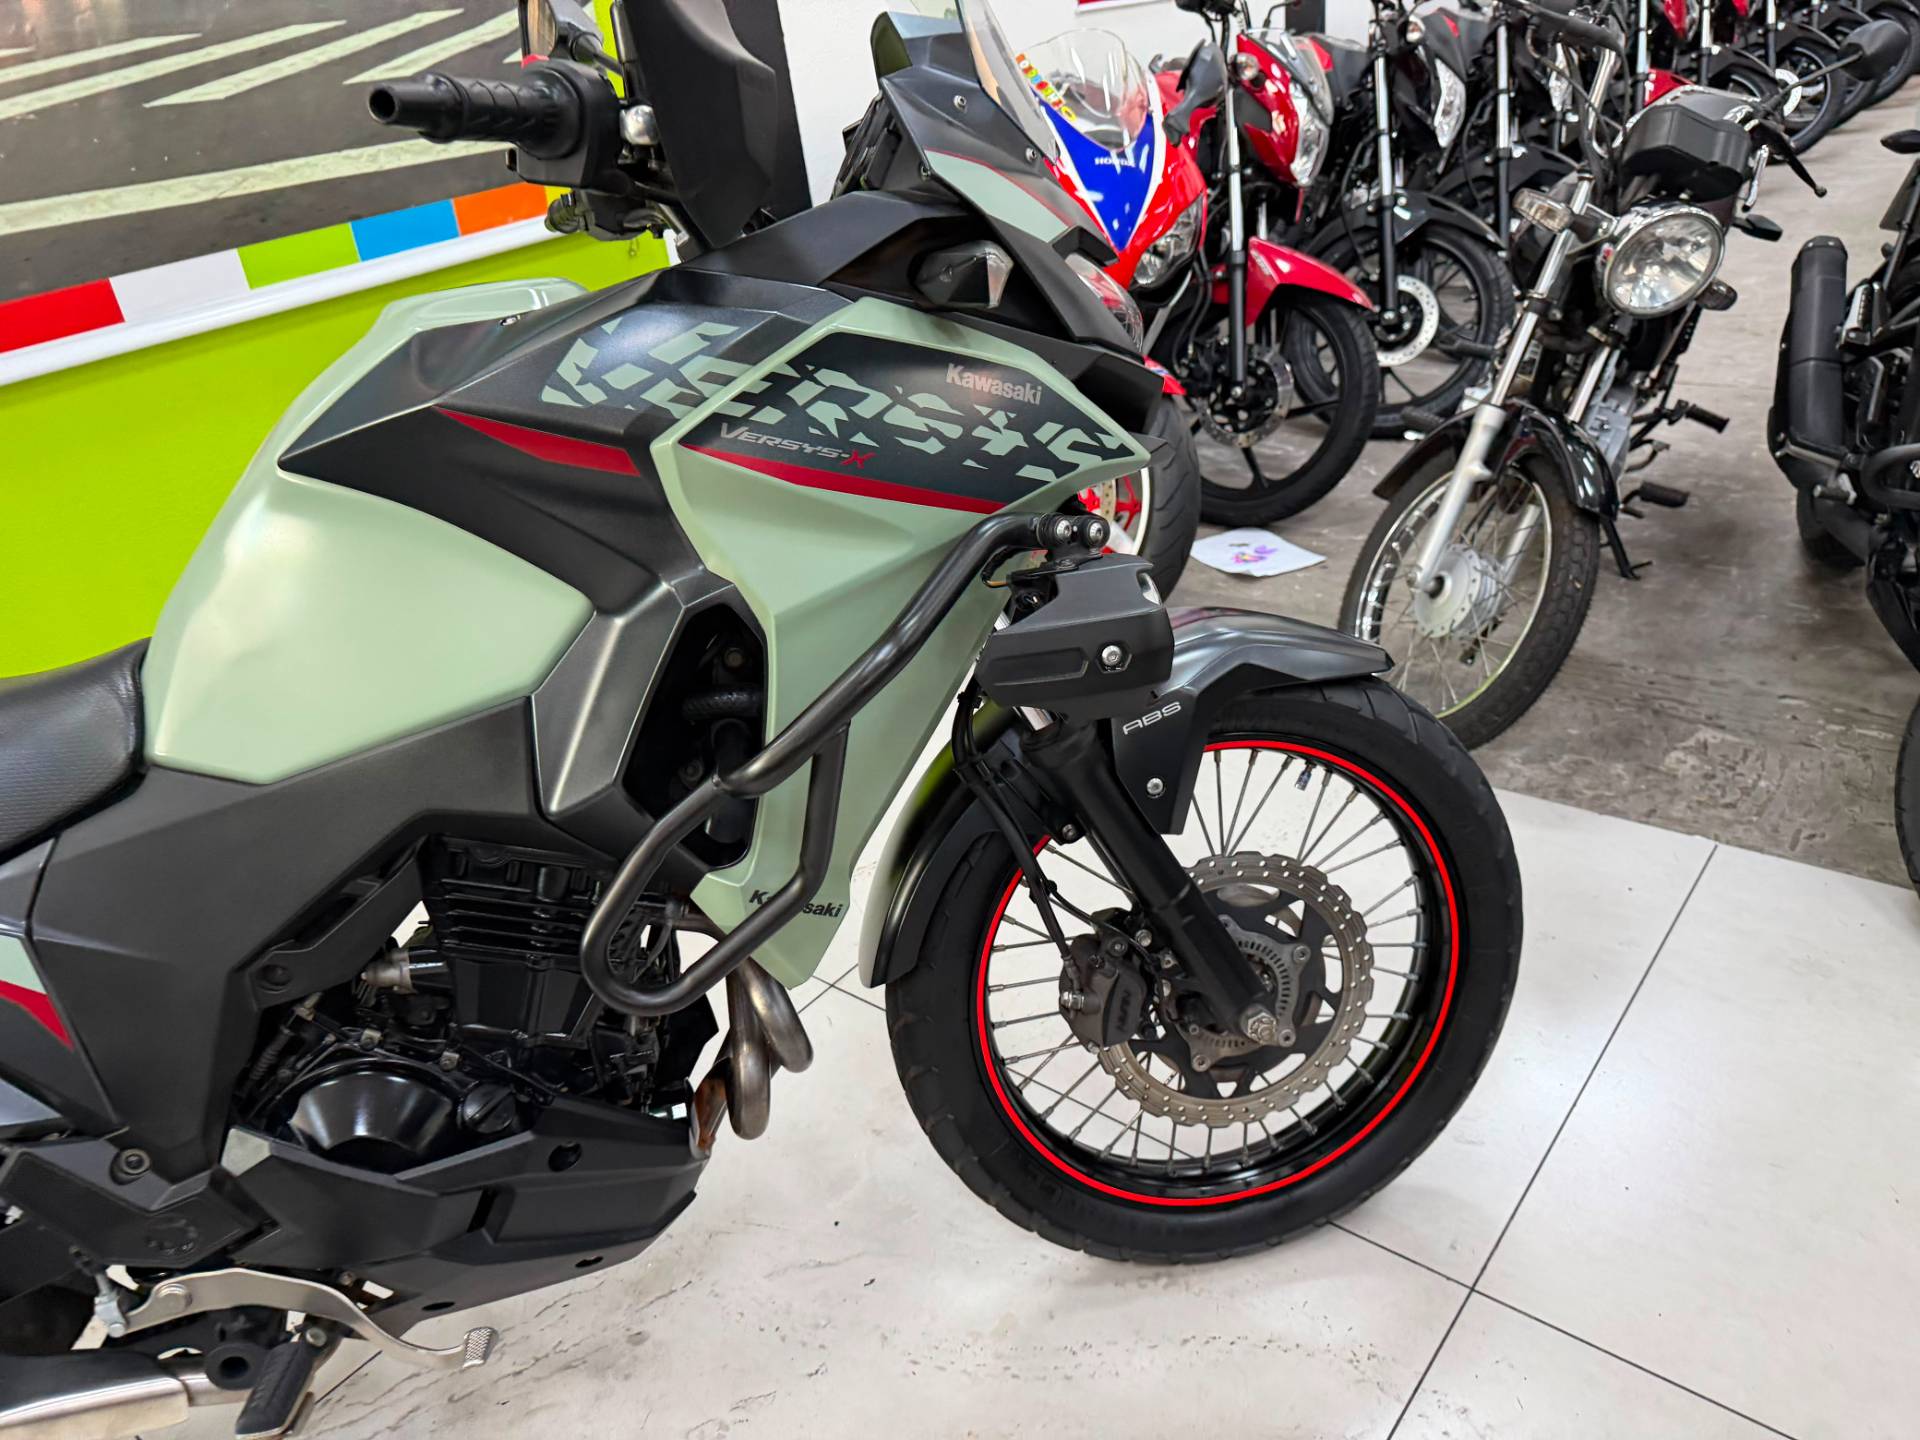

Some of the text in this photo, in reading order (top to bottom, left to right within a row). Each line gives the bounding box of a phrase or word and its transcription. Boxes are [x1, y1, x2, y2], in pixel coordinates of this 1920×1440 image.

[946, 363, 1042, 405] Kawasaki
[1123, 701, 1181, 735] ABS
[749, 890, 843, 917] Ksaki
